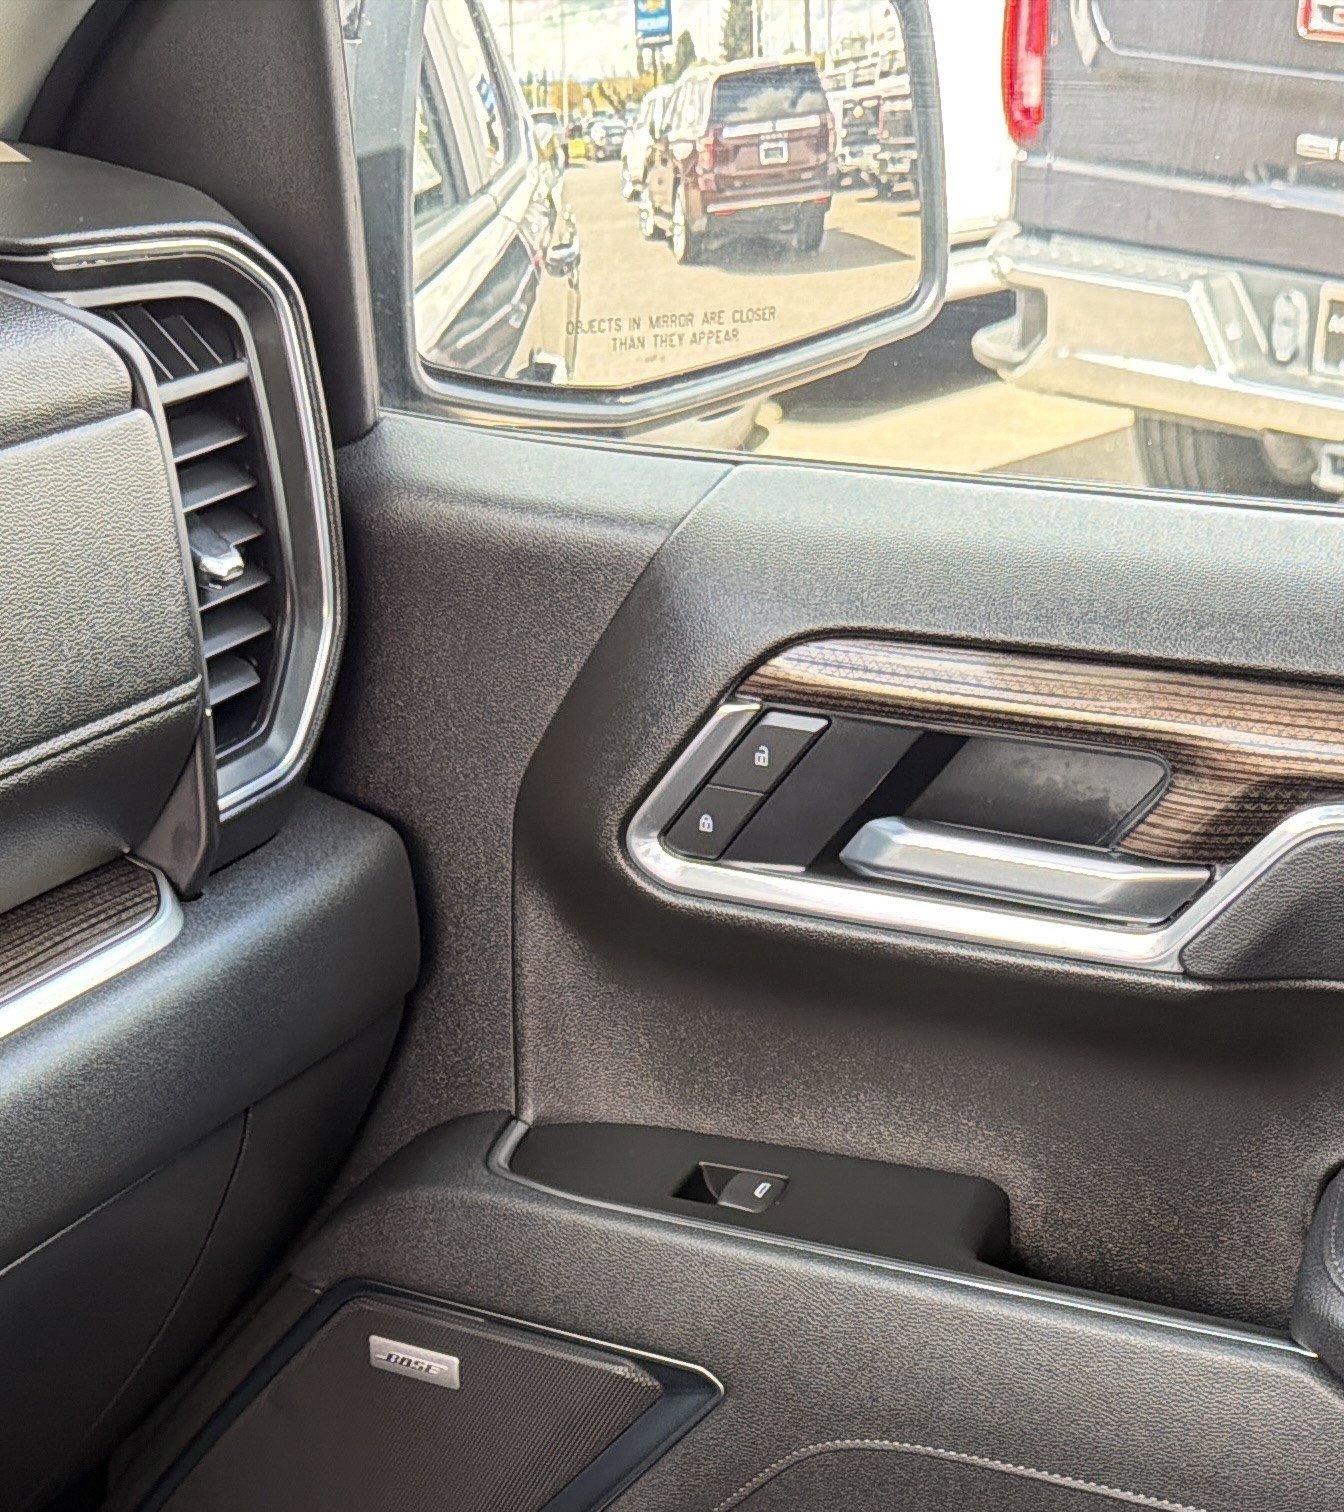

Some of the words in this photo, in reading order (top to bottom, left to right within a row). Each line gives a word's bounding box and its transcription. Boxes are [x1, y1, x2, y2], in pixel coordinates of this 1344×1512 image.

[566, 317, 622, 336] OBJECTS
[628, 316, 641, 332] IN
[648, 312, 695, 330] MIRROR
[701, 309, 725, 326] ARE
[731, 306, 776, 324] CLOSER
[612, 336, 646, 352] THAN
[653, 333, 686, 349] THEY
[690, 328, 740, 346] APPEAR
